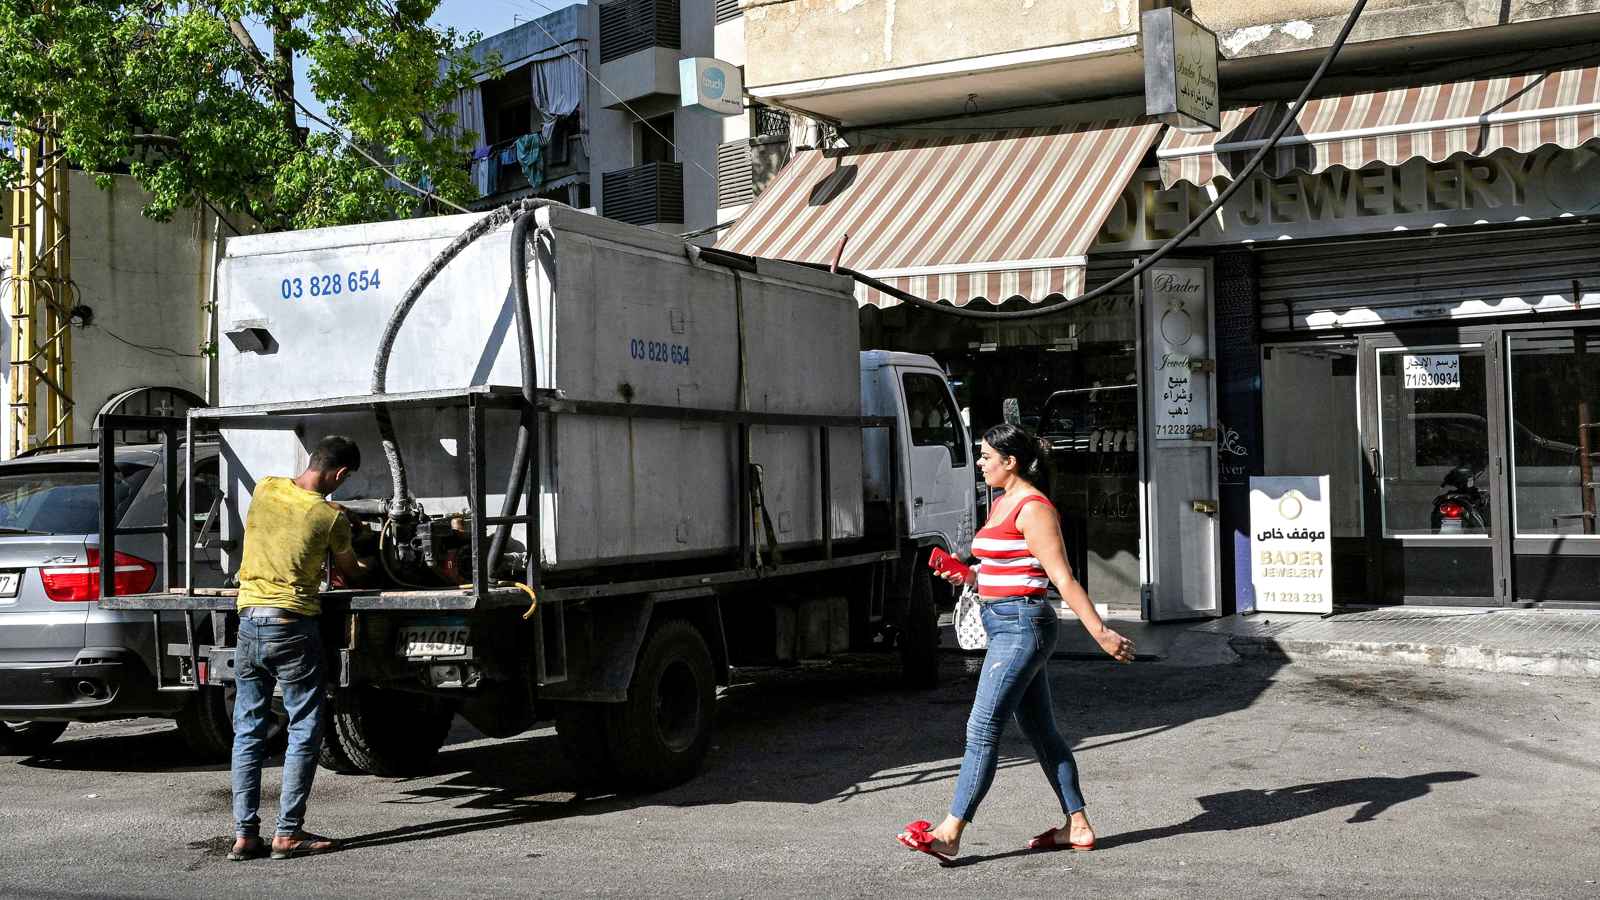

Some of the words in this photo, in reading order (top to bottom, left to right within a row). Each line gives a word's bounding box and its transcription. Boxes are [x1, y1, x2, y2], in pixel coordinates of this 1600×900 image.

[703, 77, 724, 89] touch
[1238, 153, 1533, 226] JEWELERY
[281, 278, 303, 299] 03
[310, 274, 342, 296] 828
[348, 268, 380, 292] 654
[1153, 273, 1200, 292] Bader
[631, 339, 645, 359] 03
[648, 341, 668, 362] 828
[671, 343, 689, 365] 654
[1168, 376, 1187, 389] مبيع
[1406, 373, 1458, 386] 71/930934
[1163, 389, 1193, 402] وشراء
[1168, 403, 1189, 418] ذهب
[1257, 528, 1284, 541] خاص
[1287, 528, 1325, 542] موقف
[1261, 551, 1323, 565] BADER
[1263, 568, 1324, 579] JEWELERY
[1263, 592, 1276, 602] 71
